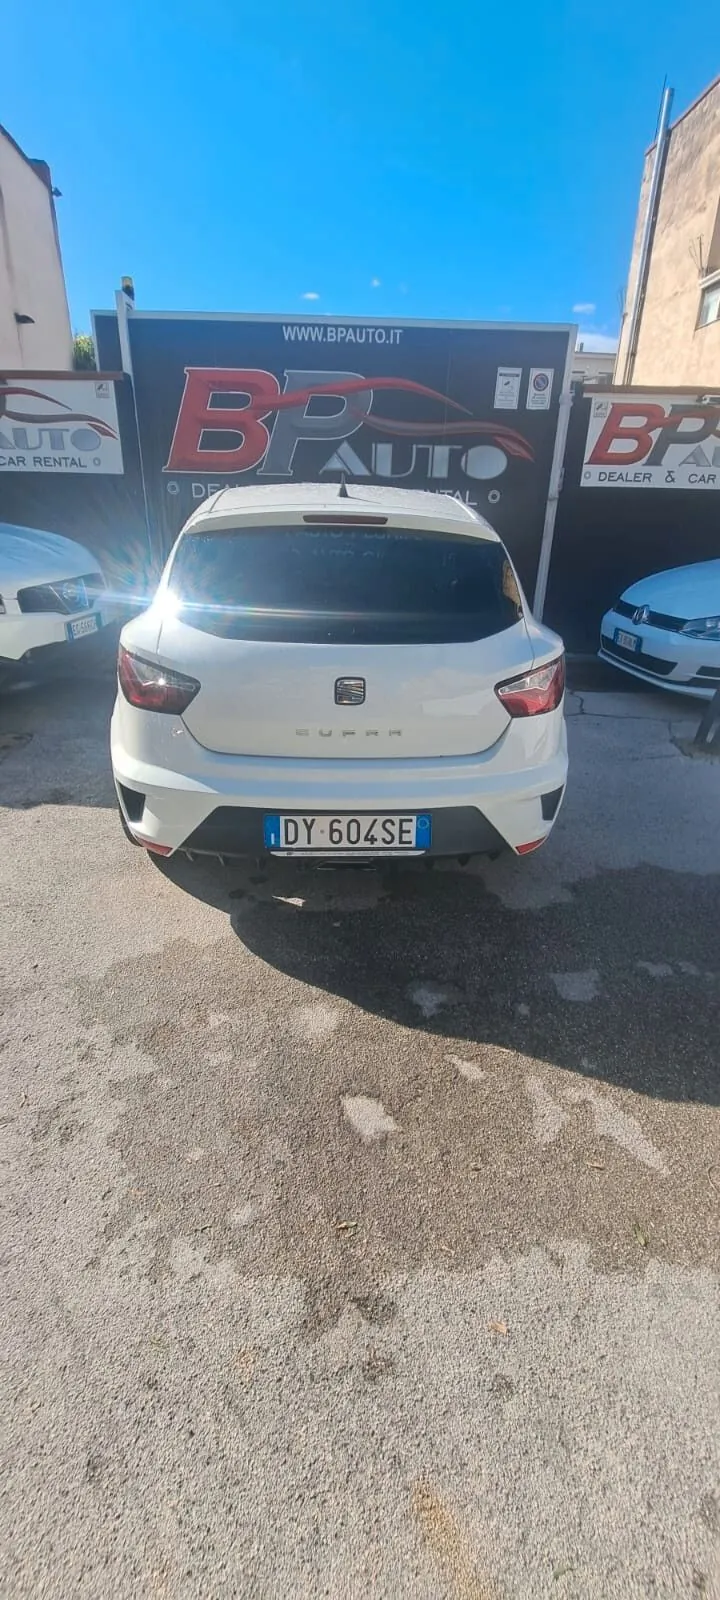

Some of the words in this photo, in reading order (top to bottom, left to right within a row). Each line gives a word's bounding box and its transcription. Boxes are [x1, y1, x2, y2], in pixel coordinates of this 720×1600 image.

[282, 325, 403, 344] WWW.BPAUTO.IT
[162, 366, 373, 475] BP
[584, 402, 719, 467] BP
[0, 456, 26, 467] CAR
[33, 456, 88, 468] RENTAL
[319, 439, 508, 480] AUTO
[598, 472, 652, 483] DEALER
[664, 470, 675, 483] &
[688, 473, 717, 484] CAR
[295, 729, 402, 737] CUPRA
[283, 818, 316, 845] DY
[328, 818, 414, 845] 604SE
